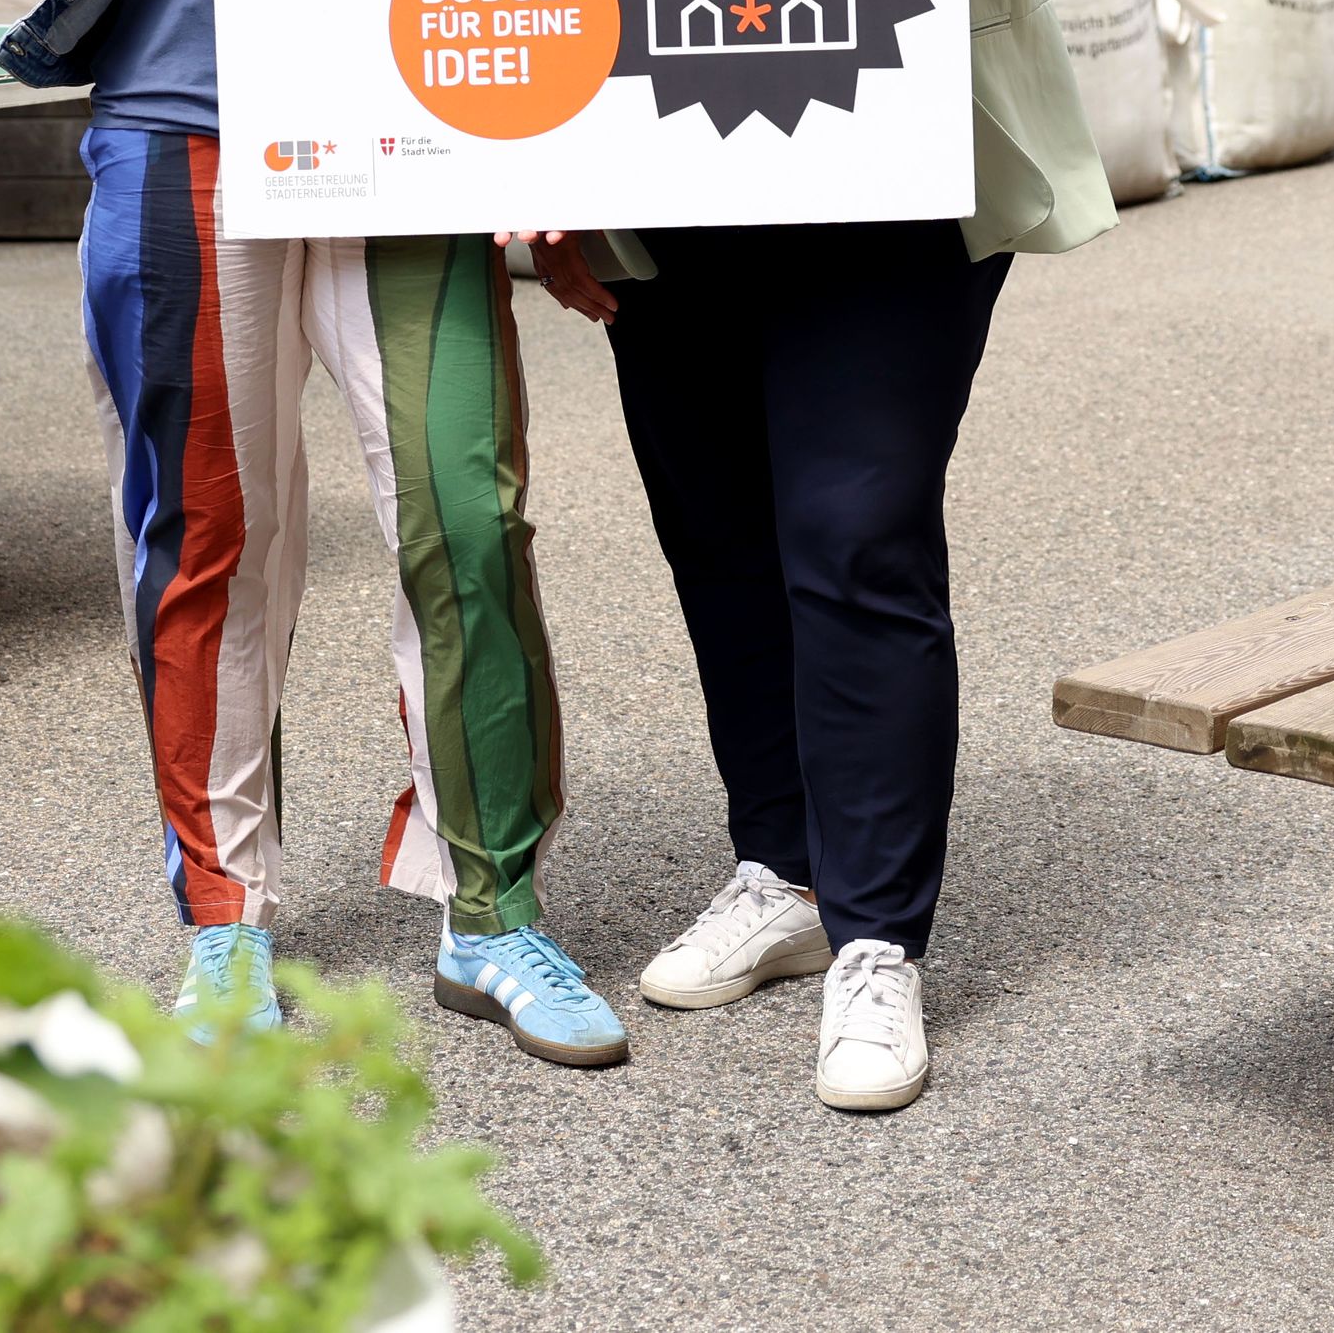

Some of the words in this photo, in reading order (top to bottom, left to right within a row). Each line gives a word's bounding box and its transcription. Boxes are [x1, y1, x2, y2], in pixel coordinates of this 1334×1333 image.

[421, 5, 481, 39] FÜR
[493, 8, 582, 37] DEINE
[423, 46, 530, 87] IDEE!
[401, 136, 416, 145] Für
[417, 136, 432, 145] die
[401, 146, 425, 156] Stadt
[427, 146, 451, 155] Wien
[265, 173, 368, 187] GEBIETSBETREUUNG
[265, 187, 367, 200] STADTERNEUERUNG
